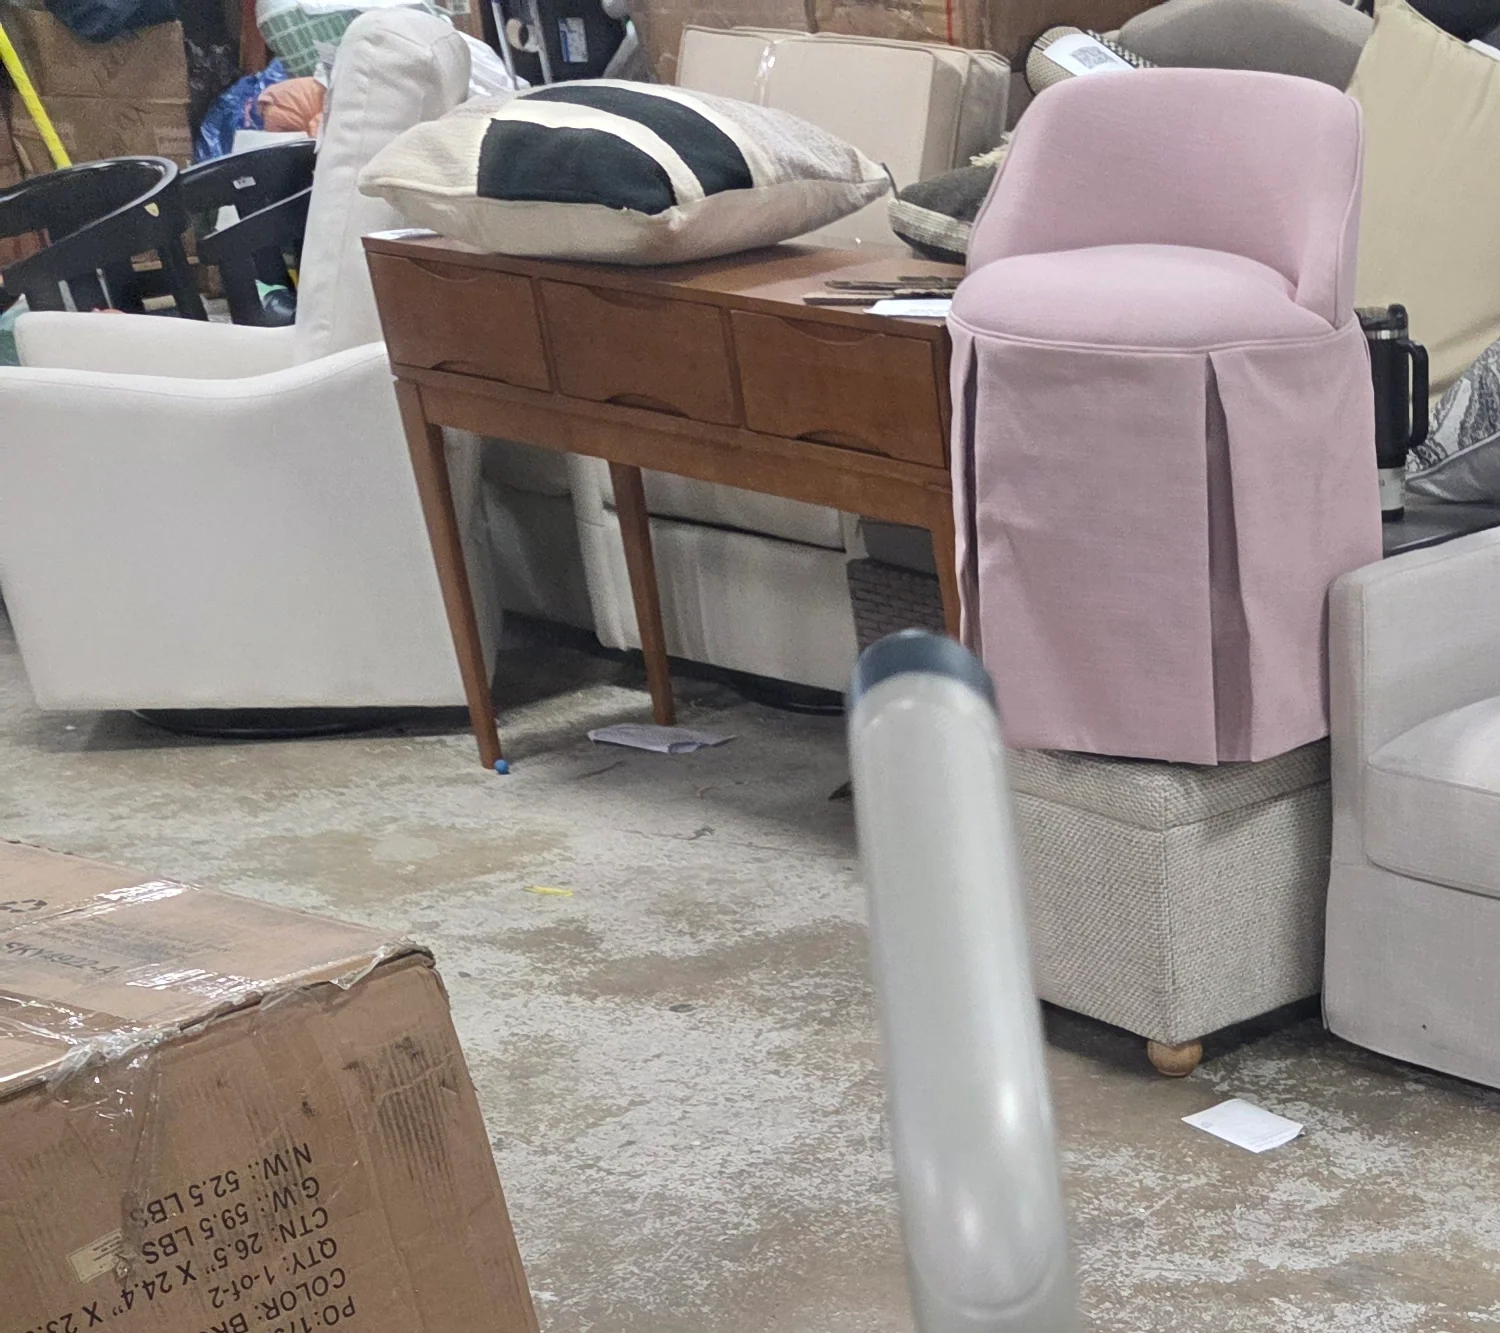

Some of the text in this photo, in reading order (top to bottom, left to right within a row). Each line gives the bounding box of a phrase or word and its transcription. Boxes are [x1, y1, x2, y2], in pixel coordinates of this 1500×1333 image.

[188, 1169, 240, 1208] 52.5
[130, 1192, 185, 1227] LBS
[198, 1202, 250, 1241] 59.5
[271, 1207, 328, 1244] CTN:
[142, 1225, 195, 1264] LBS
[175, 1260, 197, 1285] X
[208, 1237, 338, 1309] QTY: 1-of-2
[254, 1267, 346, 1322] COLOR:
[81, 1301, 103, 1328] X
